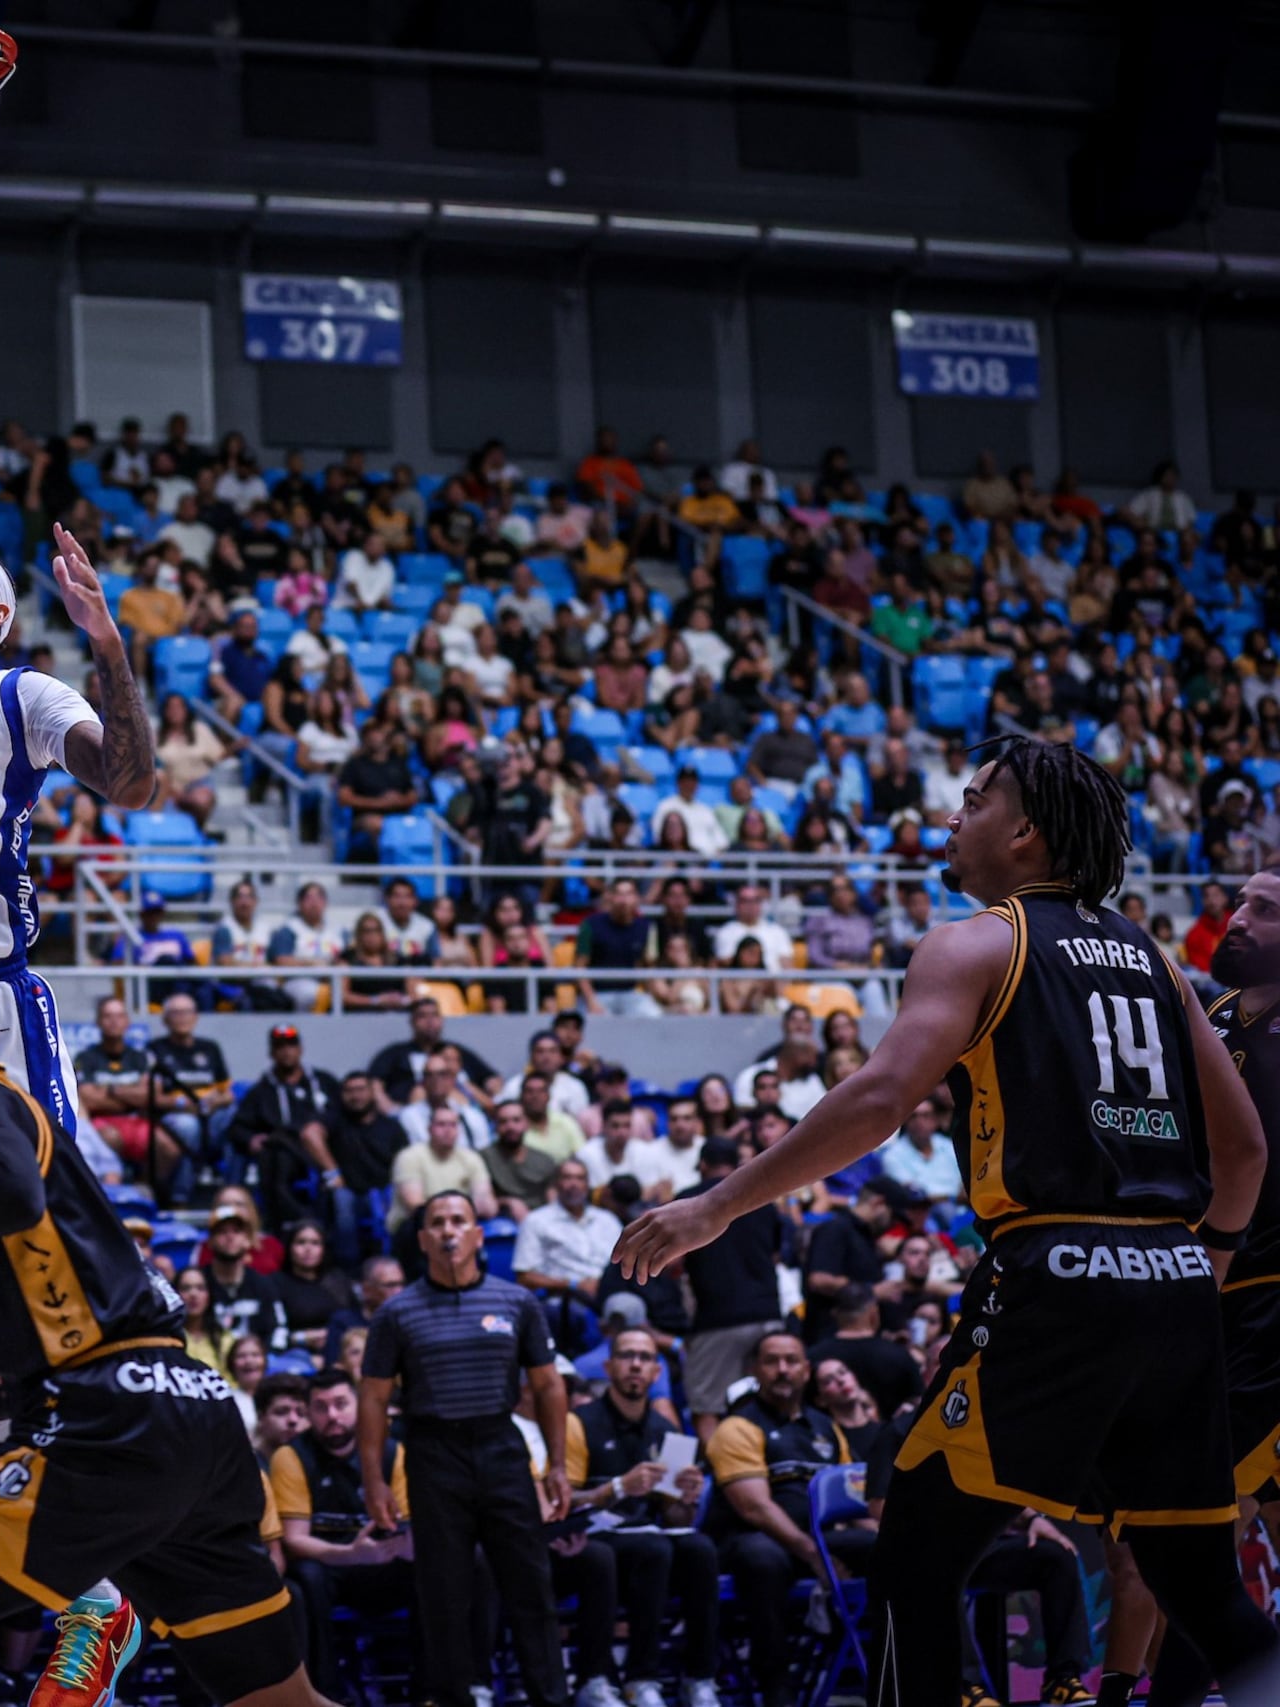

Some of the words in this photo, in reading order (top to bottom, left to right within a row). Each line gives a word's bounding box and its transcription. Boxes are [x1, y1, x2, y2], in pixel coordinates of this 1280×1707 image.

[280, 319, 368, 360] 307
[930, 355, 1010, 395] 308
[1056, 937, 1153, 977] TORRES
[1087, 990, 1170, 1100] 14
